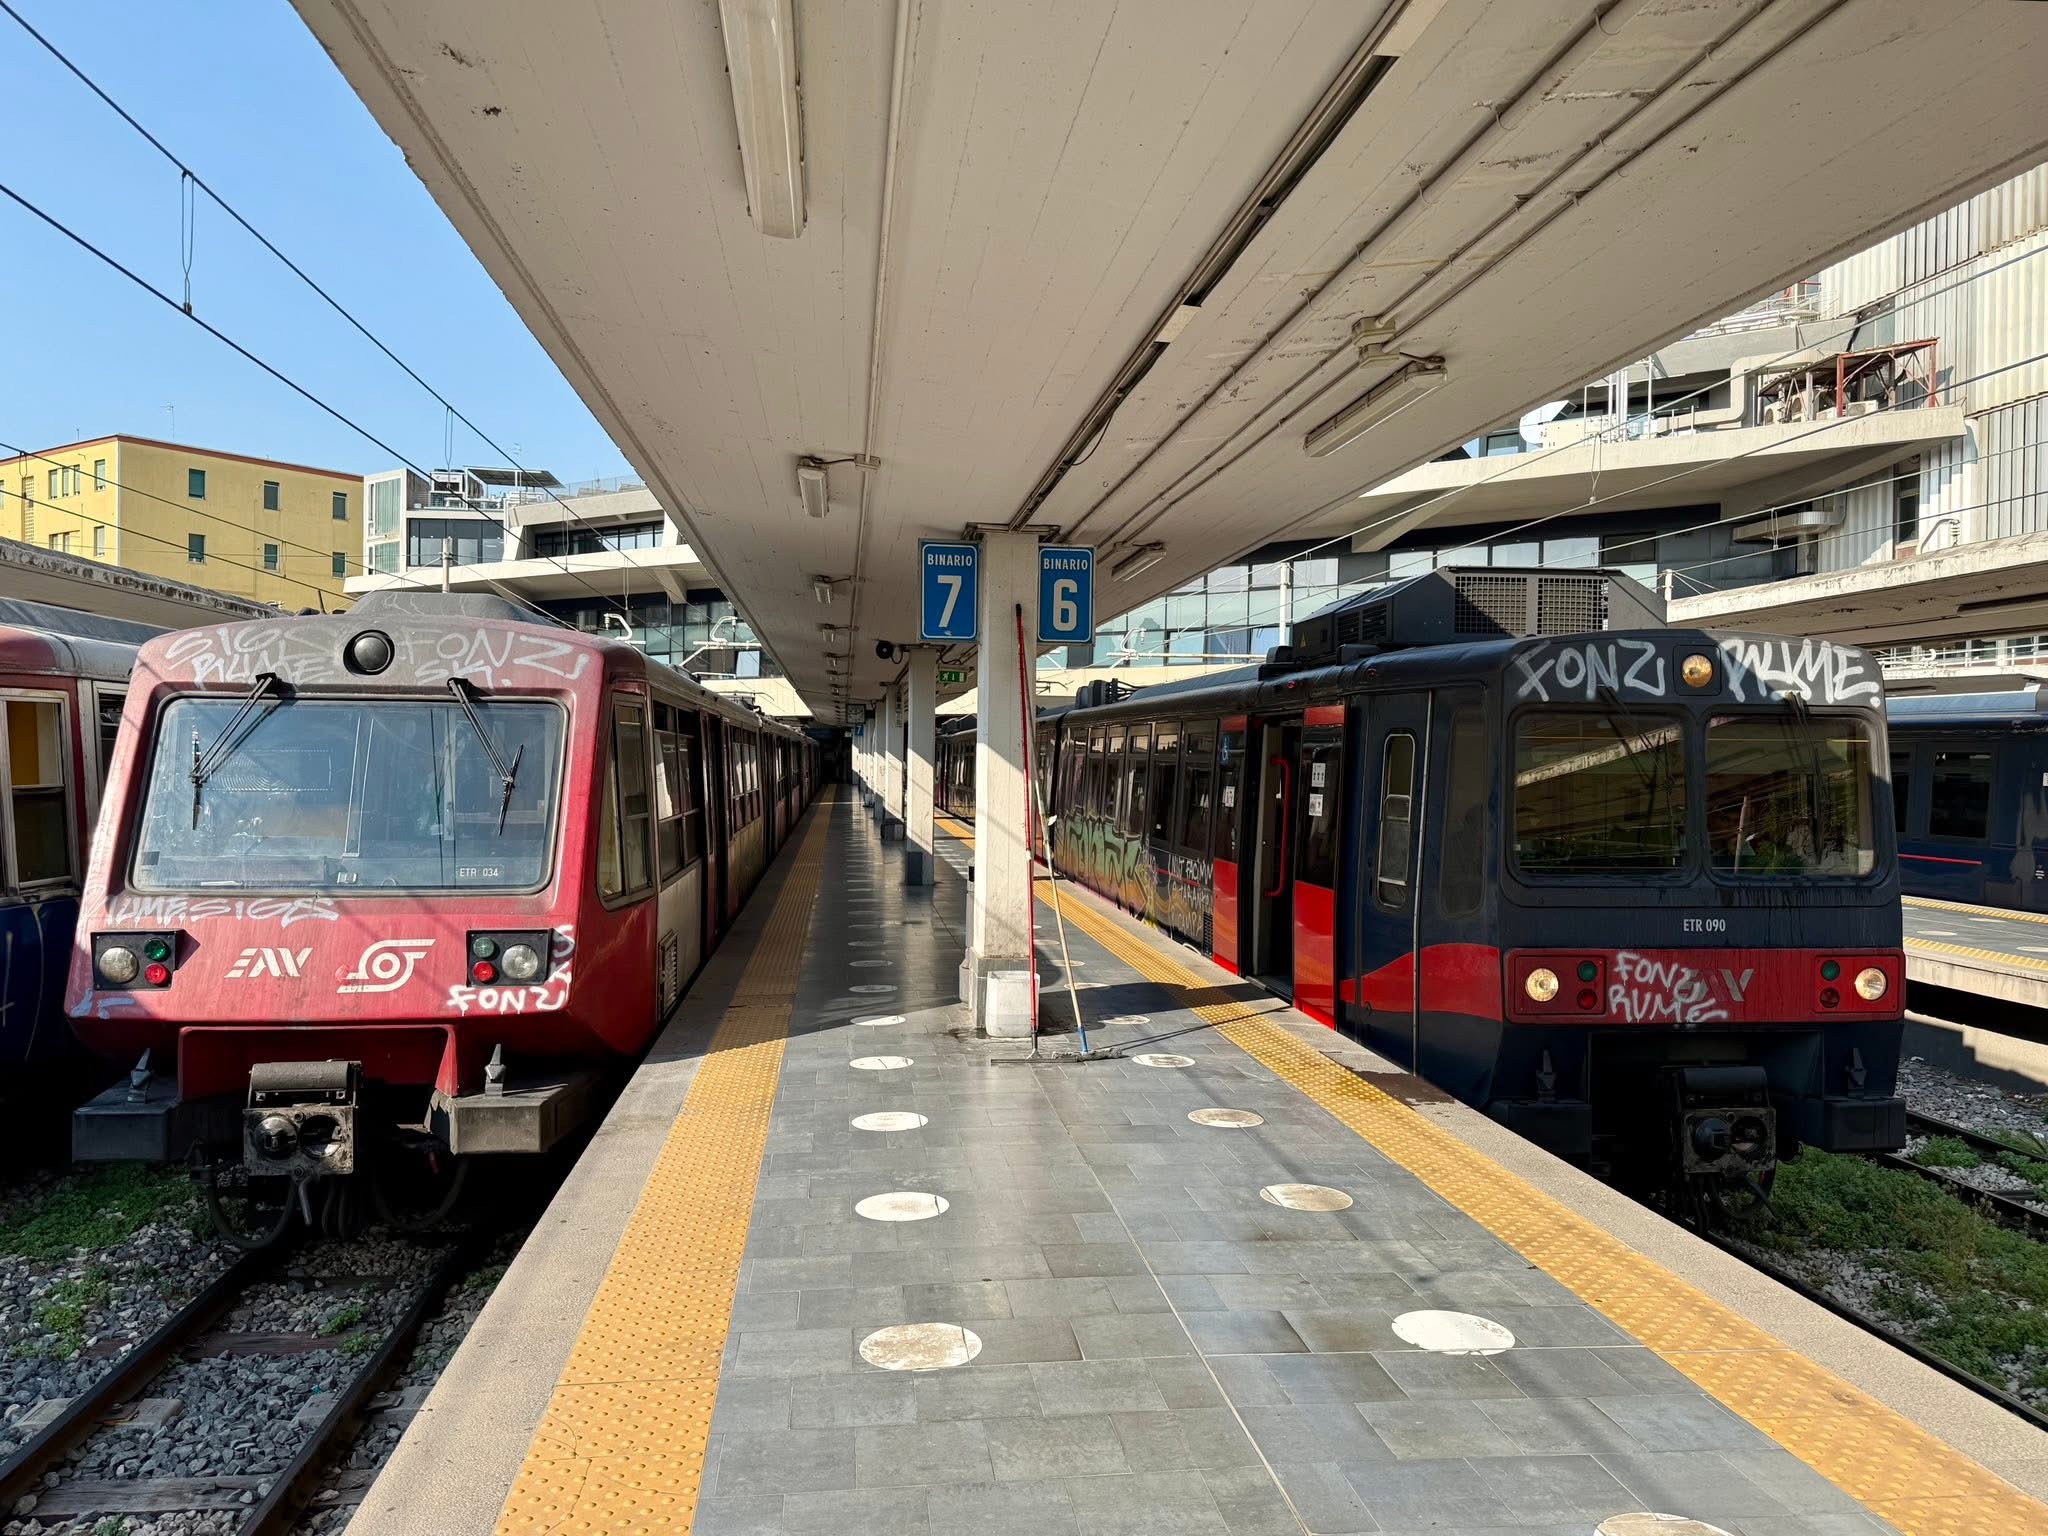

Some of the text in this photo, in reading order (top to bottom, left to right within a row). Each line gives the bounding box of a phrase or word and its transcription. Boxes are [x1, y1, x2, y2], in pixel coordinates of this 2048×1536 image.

[926, 553, 974, 567] BINARIO
[1043, 558, 1089, 571] BINARIO
[937, 575, 963, 628] 7
[1053, 579, 1078, 632] 6
[459, 867, 499, 878] ETR 034
[1683, 919, 1726, 931] ETR 090
